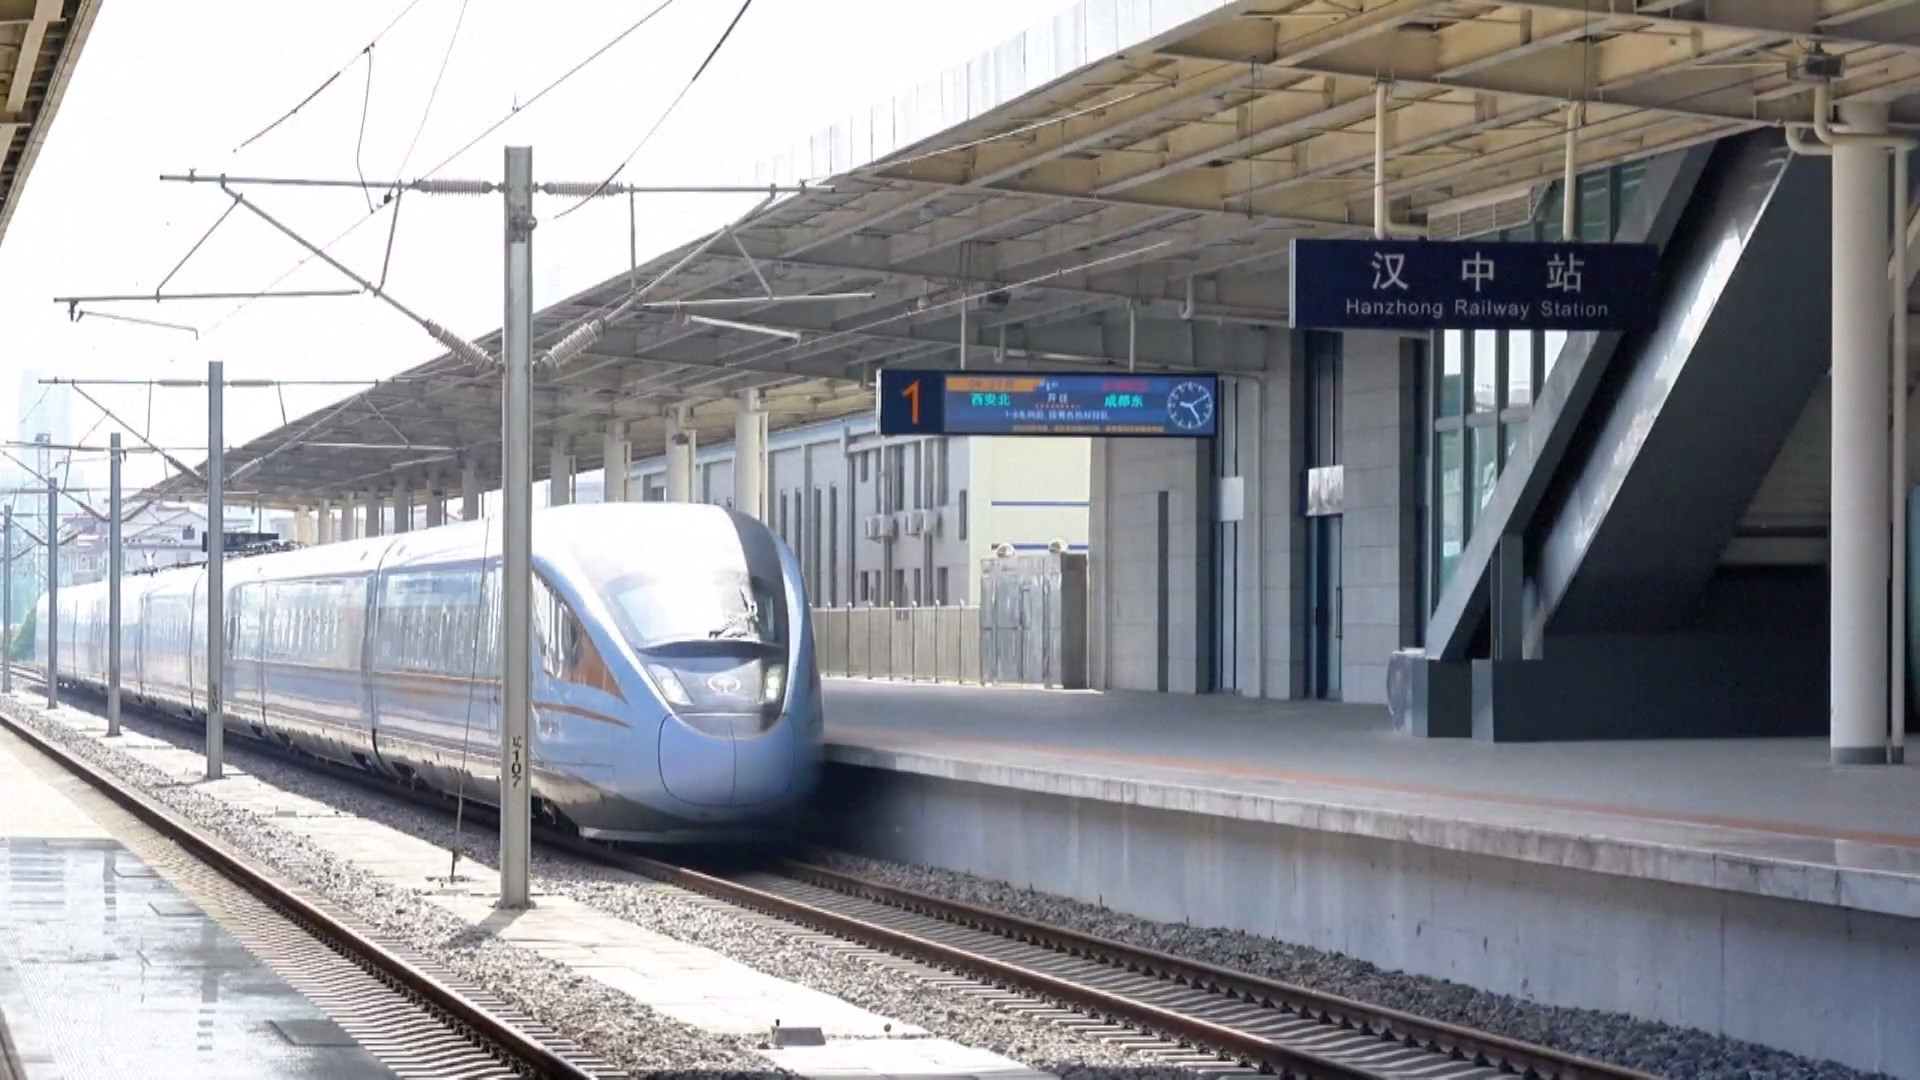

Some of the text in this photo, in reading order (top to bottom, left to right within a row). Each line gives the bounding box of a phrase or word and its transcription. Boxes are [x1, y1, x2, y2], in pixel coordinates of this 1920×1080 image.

[1371, 250, 1585, 293] 汉中站
[1345, 298, 1608, 321] Hanzhong Railway Station
[901, 379, 920, 424] 1
[971, 392, 1010, 407] 西安北
[1104, 392, 1143, 408] 成都东
